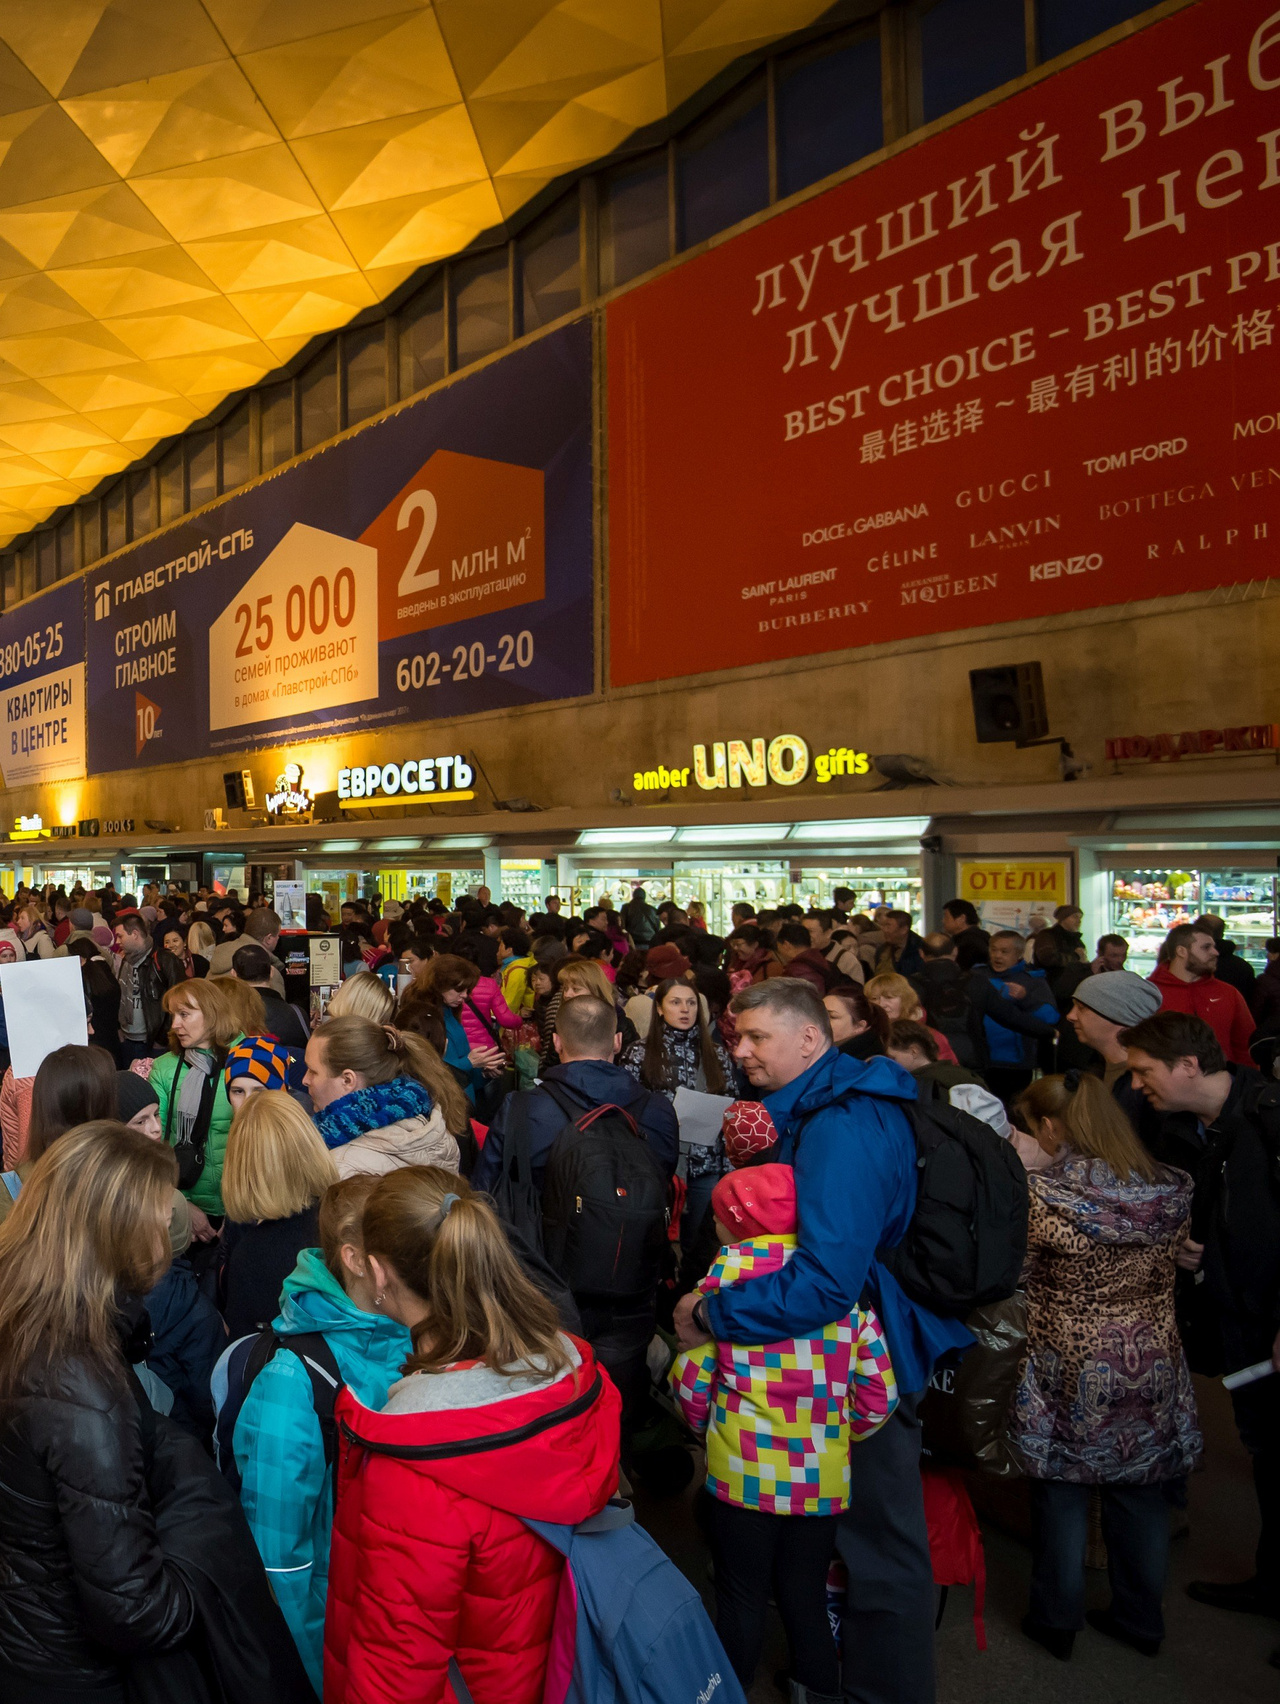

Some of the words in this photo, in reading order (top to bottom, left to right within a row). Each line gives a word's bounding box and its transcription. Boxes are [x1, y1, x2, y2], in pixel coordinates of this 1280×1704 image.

[751, 121, 1064, 315] лучший
[782, 211, 1084, 373] лучшая
[784, 387, 870, 441] BEST
[878, 328, 1036, 407] CHOICE
[1083, 265, 1213, 341] BEST
[859, 397, 985, 465] 最佳选择
[1082, 451, 1127, 476] TOM
[1130, 437, 1188, 466] FORD
[955, 469, 1051, 508] GUCCI
[1099, 482, 1216, 521] BOTTEGA
[396, 489, 440, 598] 2
[969, 514, 1061, 549] LANVIN
[1147, 522, 1268, 560] RALPH
[867, 543, 939, 573] CÉLINE
[1030, 553, 1104, 582] KENZO
[397, 598, 438, 620] введены
[441, 595, 447, 607] в
[449, 571, 527, 606] эксплуатацию
[741, 581, 776, 600] SAINT
[778, 567, 838, 593] LAURENT
[769, 590, 808, 606] PARIS
[234, 594, 274, 659] 25
[285, 566, 356, 641] 000
[758, 600, 872, 633] BURBERRY
[115, 609, 177, 657] СТРОИМ
[115, 647, 177, 689] ГЛАВНОЕ
[234, 654, 271, 683] семей
[275, 636, 358, 677] проживают
[396, 629, 534, 692] 602-20-20
[7, 678, 72, 723] КВАРТИРЫ
[234, 696, 241, 708] в
[242, 688, 270, 708] домах
[11, 731, 18, 756] В
[21, 717, 68, 757] ЦЕНТРЕ
[137, 705, 155, 741] 10
[1105, 723, 1273, 763] ПОДАРКИ
[338, 754, 473, 799] ЕВРОСЕТЬ
[633, 765, 690, 791] amber
[692, 733, 809, 790] UNO
[815, 746, 870, 785] gifts
[103, 819, 132, 833] BOOKS
[969, 871, 1057, 890] ОТЕЛИ
